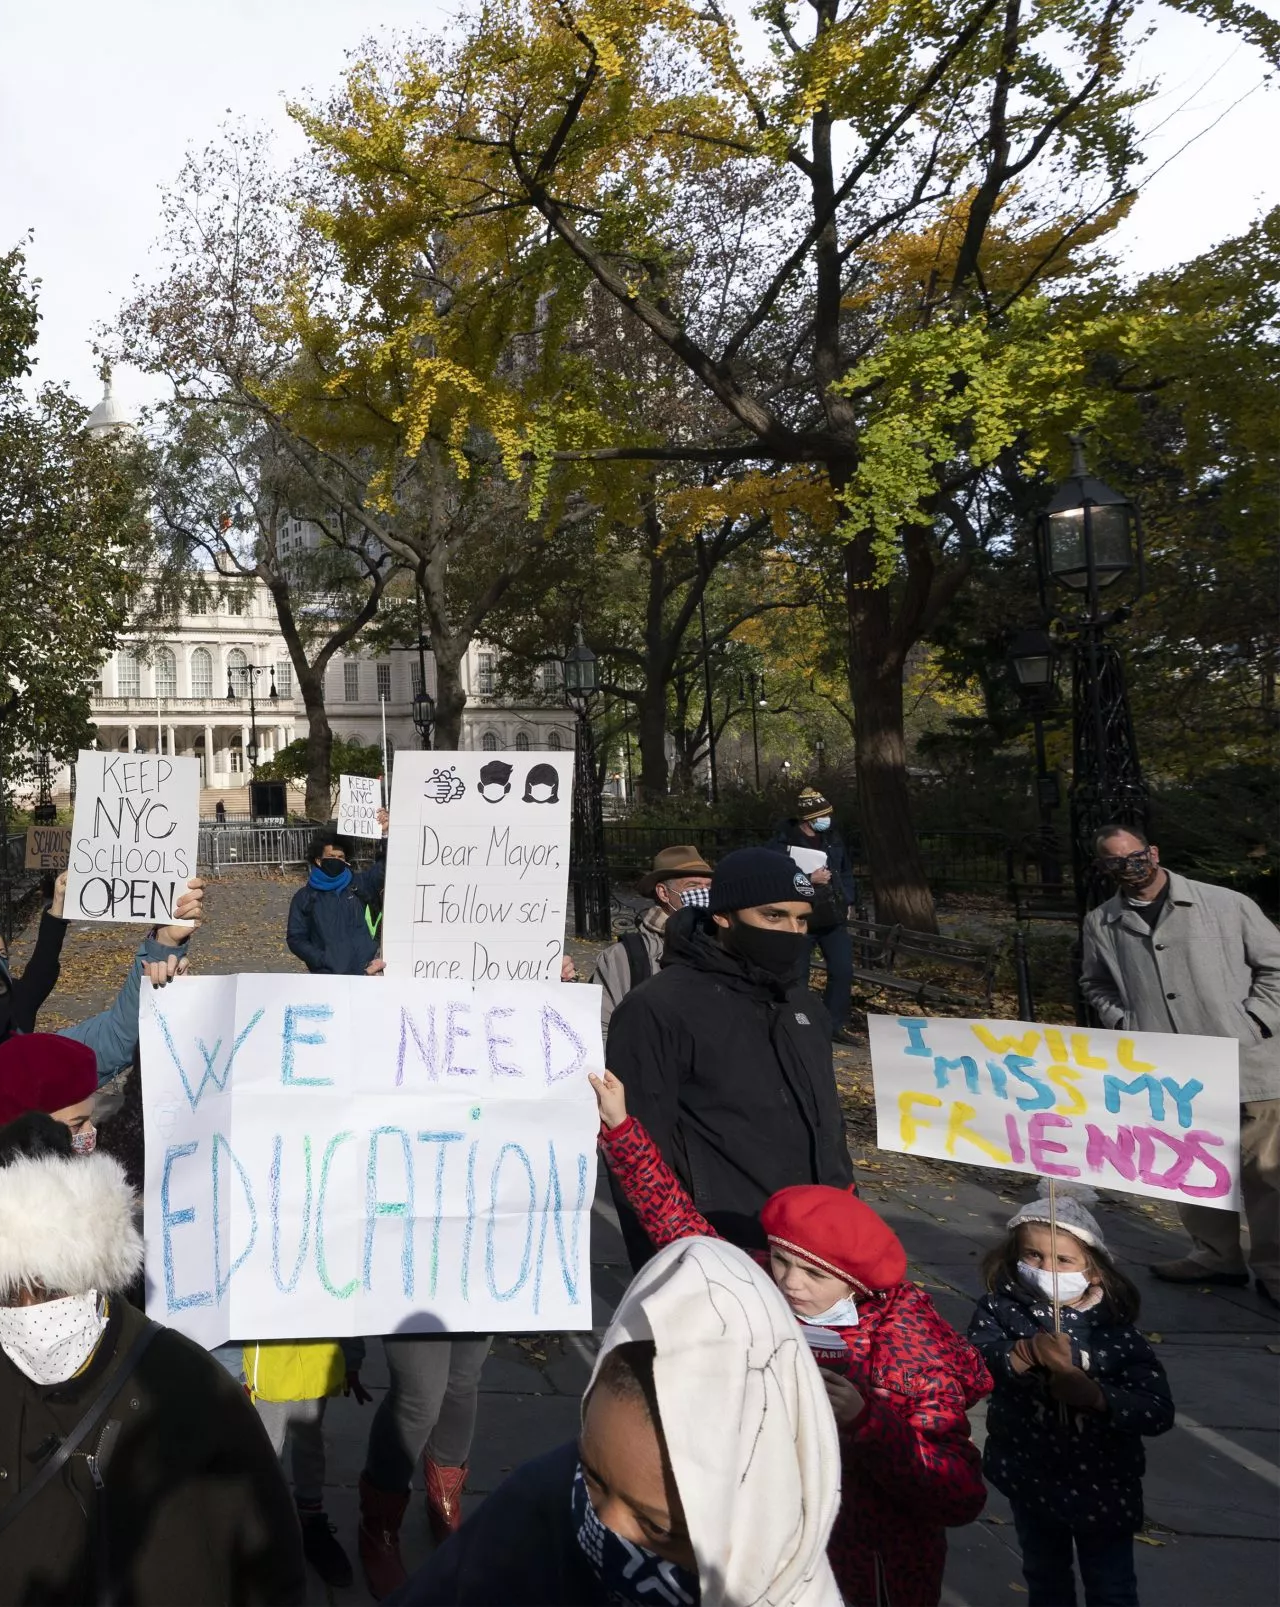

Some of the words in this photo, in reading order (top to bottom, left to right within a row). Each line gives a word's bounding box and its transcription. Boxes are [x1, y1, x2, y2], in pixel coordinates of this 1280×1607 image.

[102, 756, 173, 794] KEEP
[348, 776, 375, 790] KEEP
[350, 789, 373, 804] NYC
[93, 796, 177, 843] NYC
[343, 818, 374, 834] OPEN
[31, 830, 71, 855] SCHOOLS
[73, 838, 189, 879] SCHOOLS
[421, 825, 477, 866] Dear
[485, 825, 560, 880] Mayor,
[79, 877, 176, 920] OPEN
[413, 884, 436, 923] I
[439, 884, 513, 923] follow
[516, 898, 560, 923] sci-
[472, 941, 500, 982] Do
[506, 939, 562, 980] you?
[150, 999, 334, 1113] WE
[395, 1001, 587, 1088] NEED
[898, 1018, 933, 1058] I
[970, 1023, 1157, 1073] WILL
[933, 1054, 1090, 1116] MISS
[1104, 1073, 1204, 1128] MY
[898, 1090, 1232, 1199] FRIENDS
